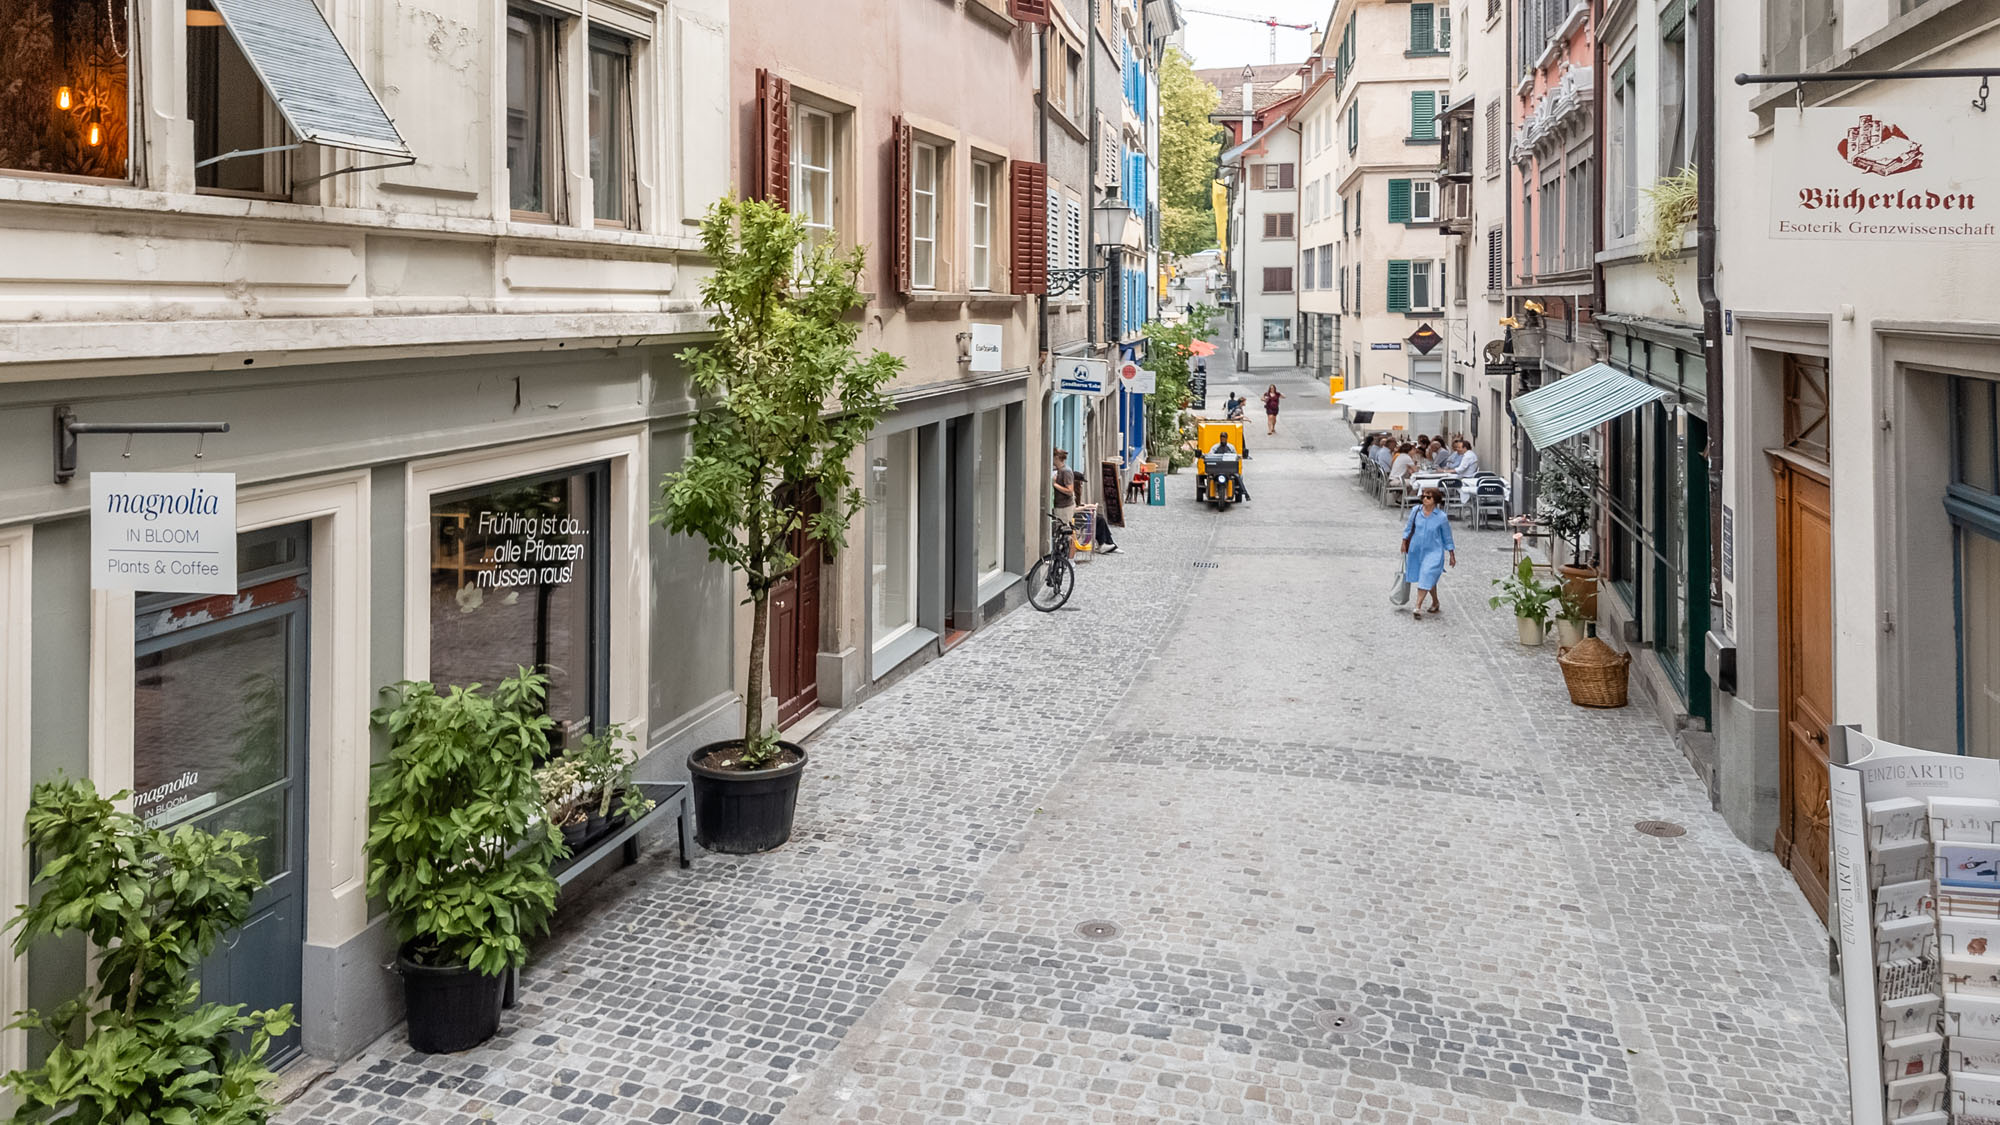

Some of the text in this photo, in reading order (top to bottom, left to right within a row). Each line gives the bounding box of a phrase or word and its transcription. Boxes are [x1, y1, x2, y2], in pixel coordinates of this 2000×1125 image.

[1798, 187, 1976, 214] Bücherladen
[1779, 220, 1995, 236] Esoterik Grenzwissenschaft
[108, 488, 219, 521] magnolia
[126, 528, 199, 543] IN BLOOM
[478, 511, 590, 540] Frühling ist da...
[479, 539, 584, 563] ...alle Pflanzen
[108, 559, 219, 575] Plants & Coffee
[477, 561, 574, 588] müssen raus!
[134, 771, 199, 808] magnolia
[144, 794, 188, 819] IN BLOOM
